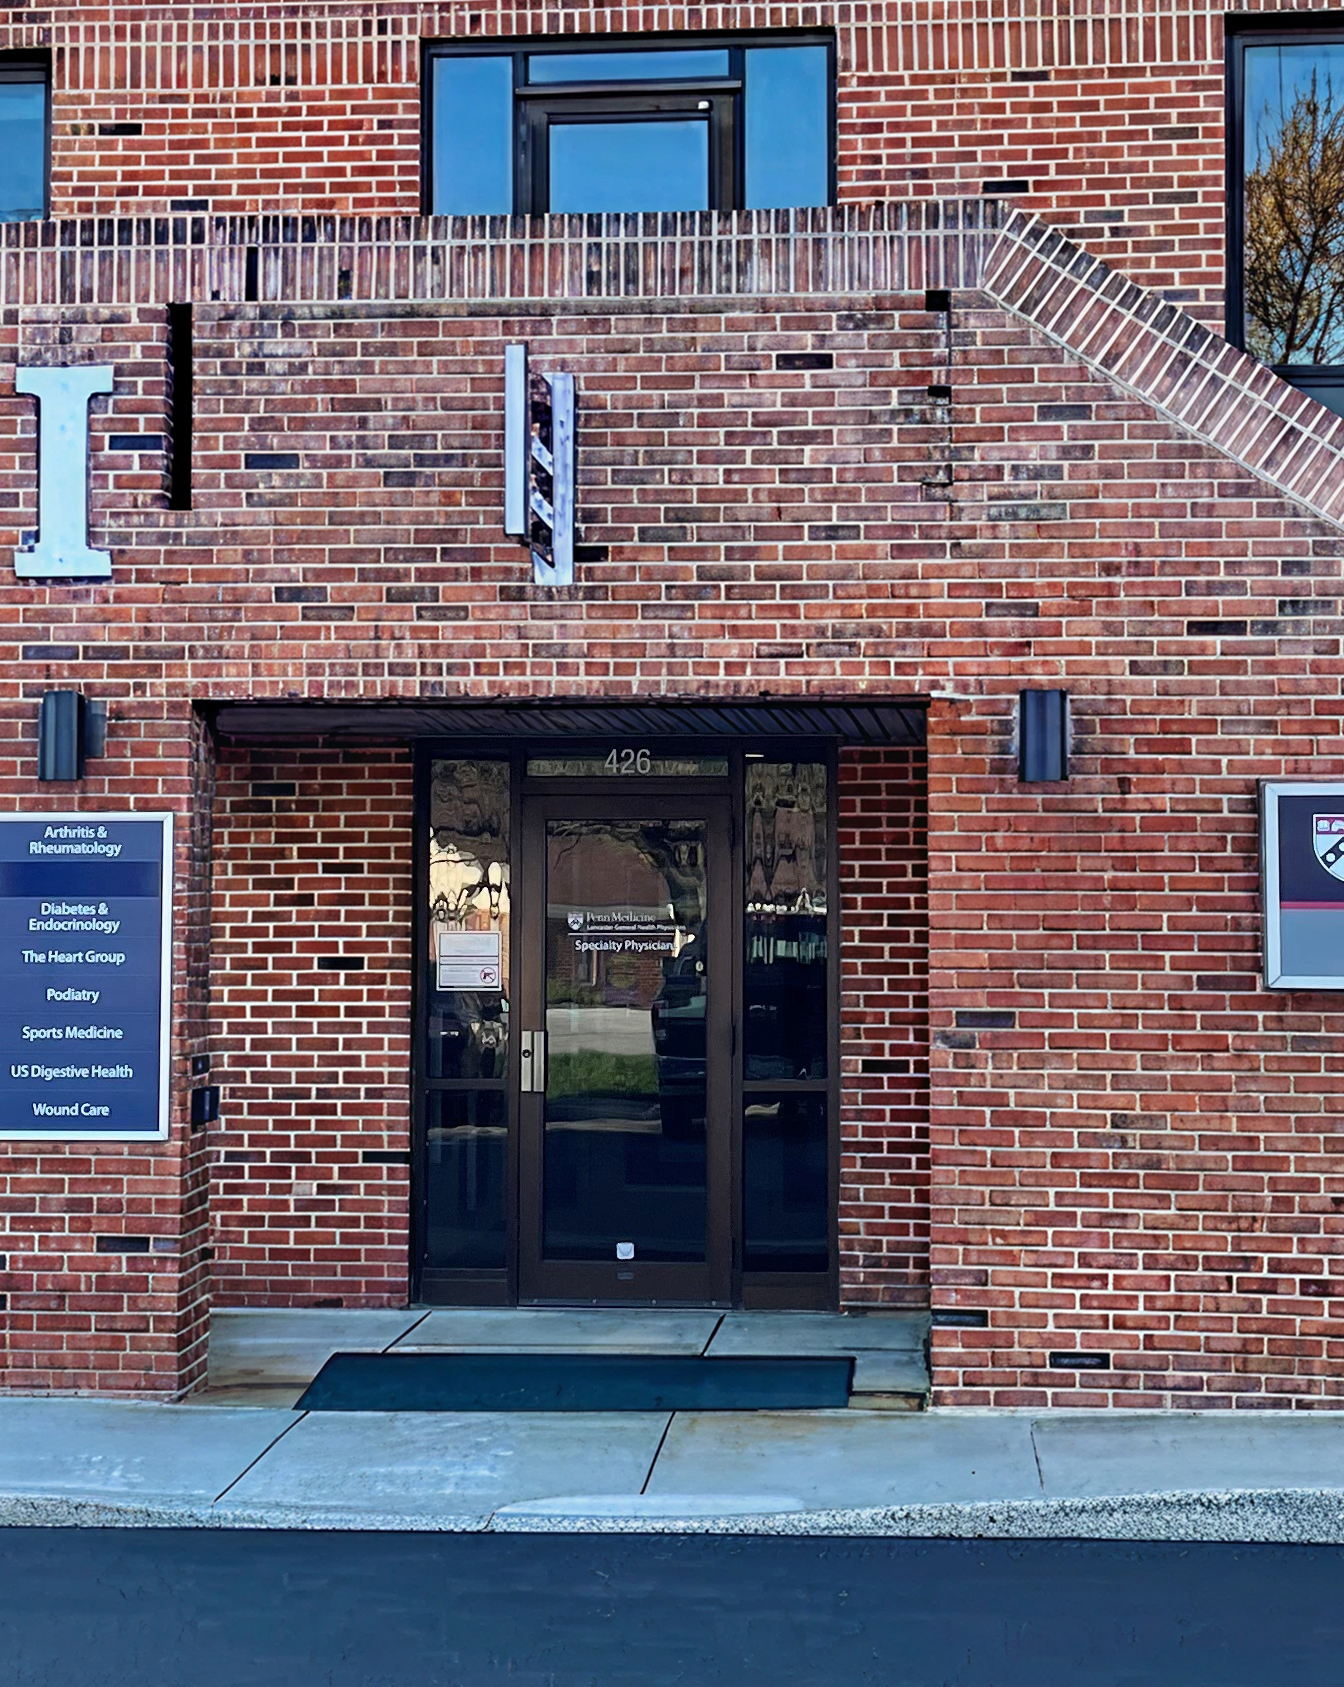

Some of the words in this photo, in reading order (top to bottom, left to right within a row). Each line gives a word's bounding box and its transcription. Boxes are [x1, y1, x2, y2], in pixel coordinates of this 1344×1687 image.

[604, 748, 651, 774] 426
[43, 825, 96, 839] Arthritis
[97, 825, 108, 839] &
[29, 841, 122, 857] Rheumatology
[40, 902, 97, 916] Diabetes
[98, 902, 109, 916] &
[586, 911, 611, 922] Penn
[612, 911, 656, 922] Medicine
[28, 917, 120, 934] Endocrinology
[575, 939, 623, 953] Specialty
[624, 939, 677, 953] Physician
[22, 949, 47, 963] The
[48, 949, 84, 963] Heart
[85, 949, 126, 966] Group
[46, 987, 100, 1004] Podiatry
[22, 1026, 64, 1041] Sports
[64, 1025, 124, 1040] Medicine
[10, 1065, 29, 1078] US
[31, 1065, 90, 1081] Digestive
[91, 1065, 134, 1078] Health
[32, 1102, 79, 1116] Wound
[80, 1102, 110, 1116] Care
